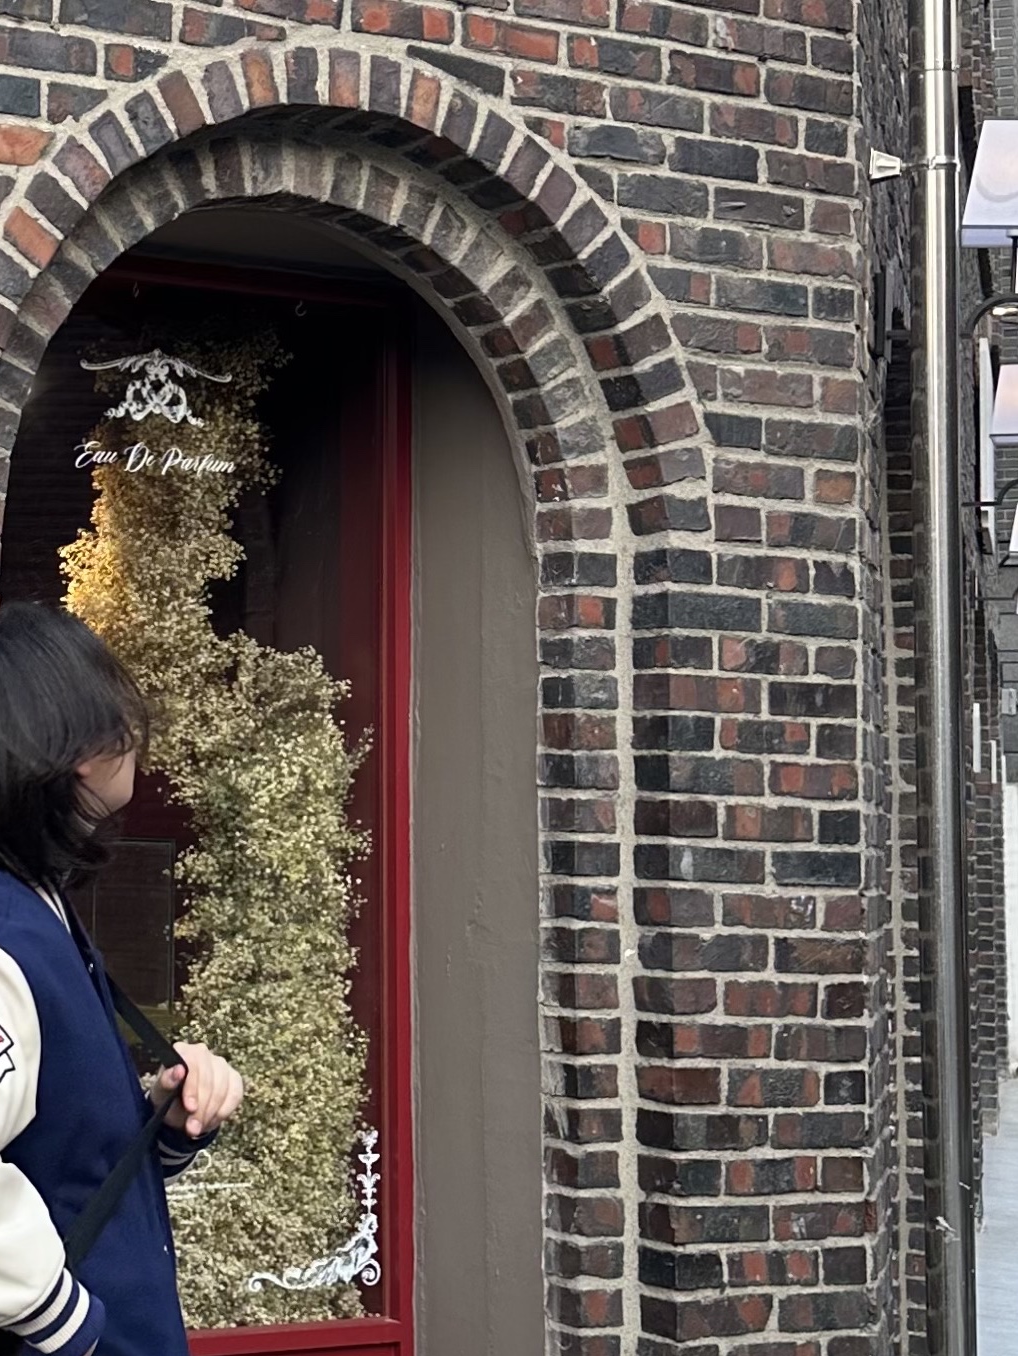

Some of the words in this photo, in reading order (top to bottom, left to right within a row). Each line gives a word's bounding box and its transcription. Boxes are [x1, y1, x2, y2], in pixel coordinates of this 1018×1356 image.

[73, 440, 119, 469] Eau
[123, 441, 156, 473] De
[160, 446, 236, 477] Parfum
